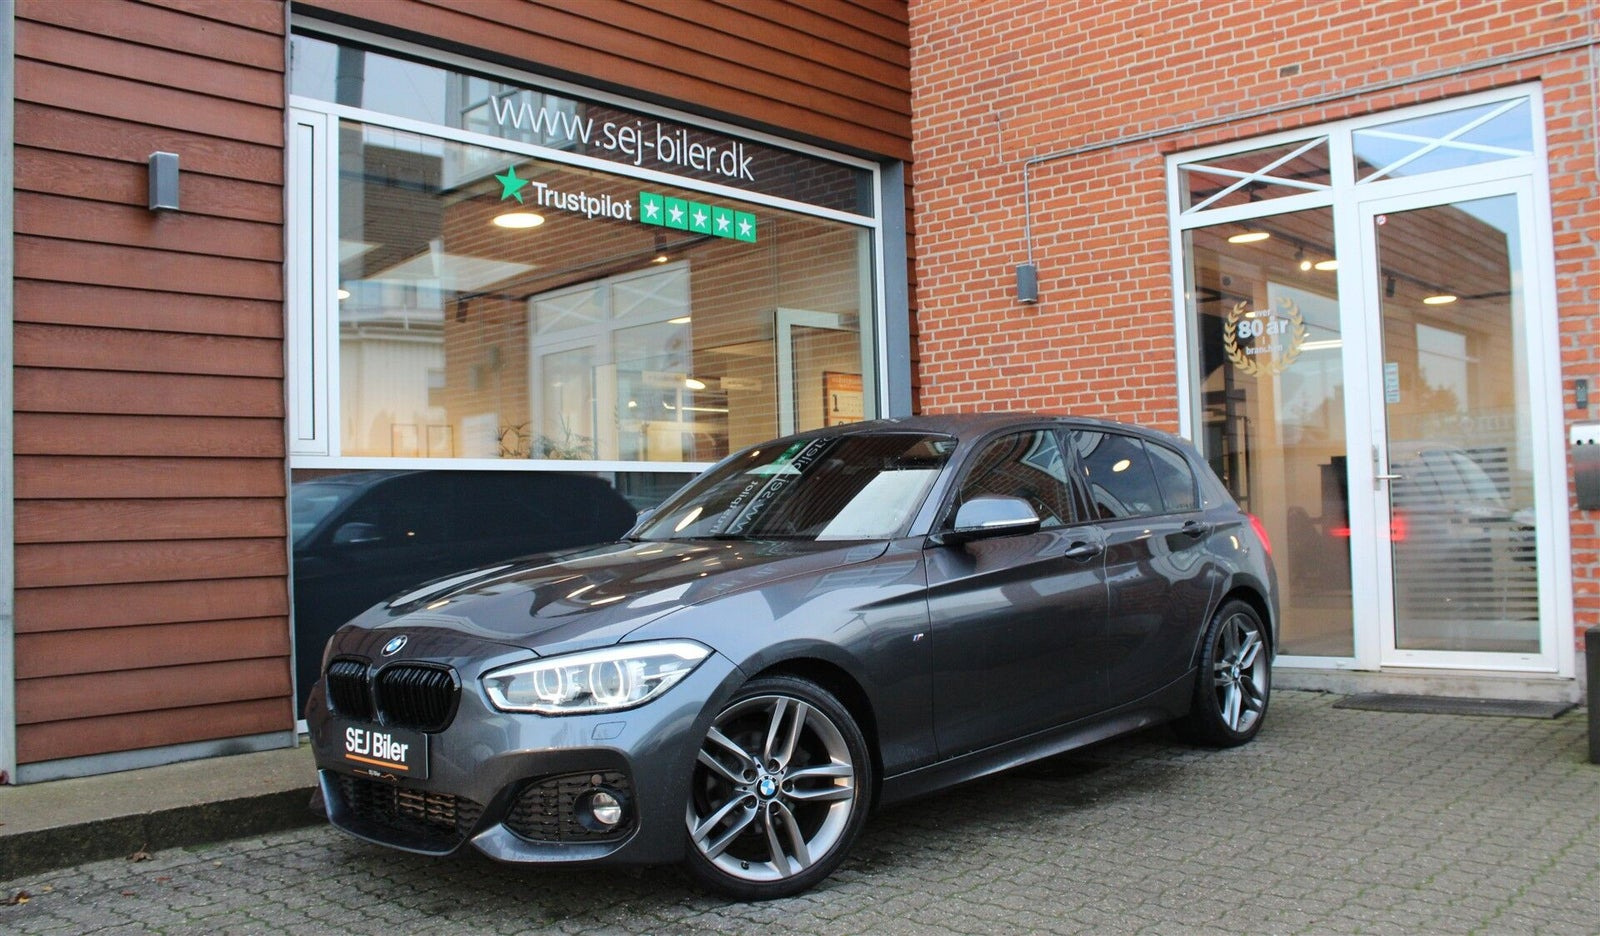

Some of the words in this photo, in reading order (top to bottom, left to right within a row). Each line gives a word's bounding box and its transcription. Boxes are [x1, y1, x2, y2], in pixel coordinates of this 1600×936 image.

[491, 95, 755, 181] www.sej-biler.dk
[532, 181, 633, 220] Trustpilot
[1238, 319, 1263, 338] 80
[1266, 316, 1288, 335] år
[345, 727, 370, 755] SEJ
[373, 732, 409, 762] Biler
